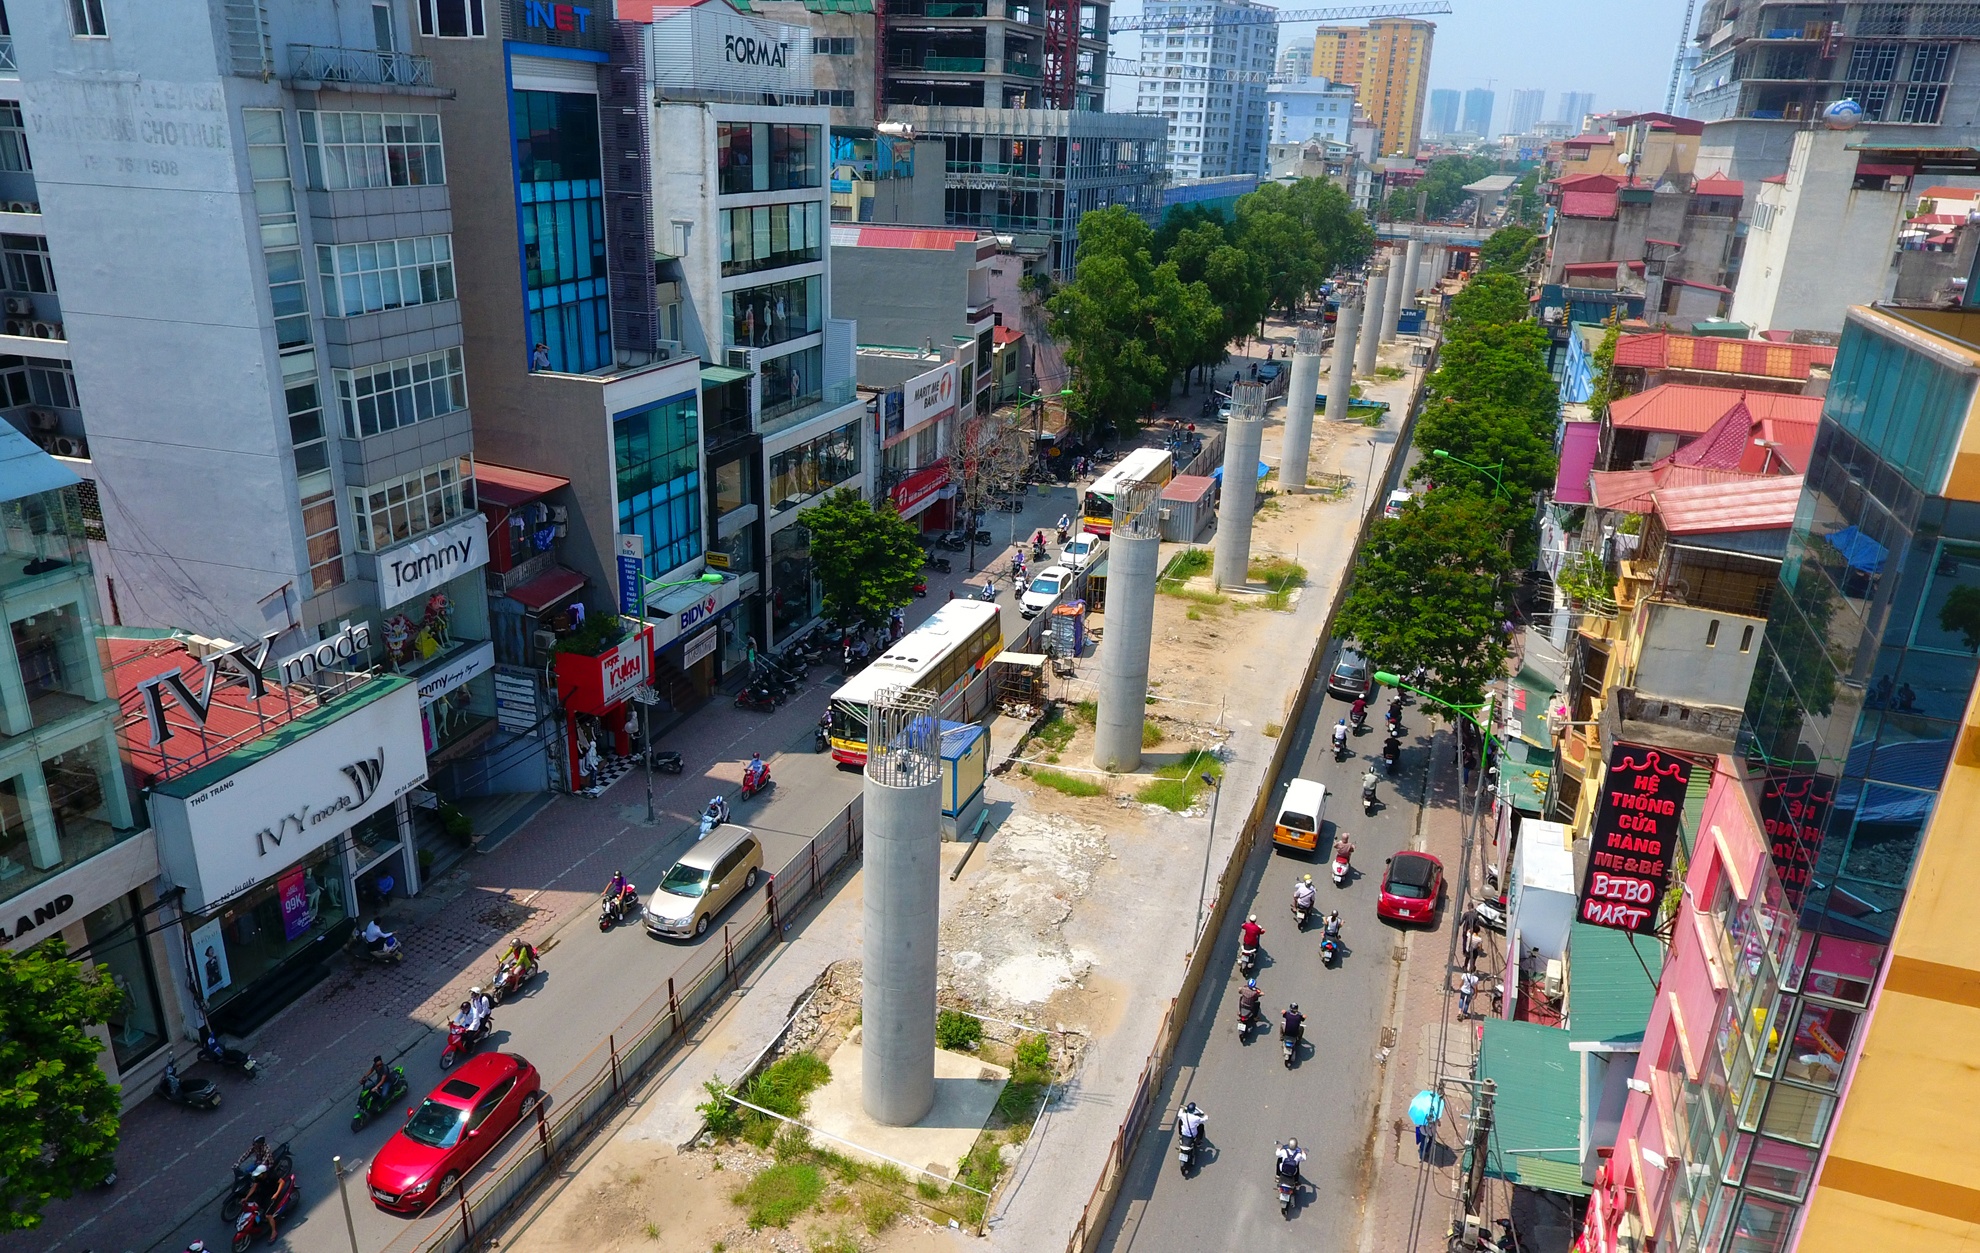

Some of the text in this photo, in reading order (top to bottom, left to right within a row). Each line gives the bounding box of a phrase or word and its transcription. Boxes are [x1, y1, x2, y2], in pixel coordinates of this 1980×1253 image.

[725, 34, 788, 68] FORMAT
[923, 392, 939, 410] BANK
[390, 536, 472, 588] Tammy
[681, 600, 706, 630] BIDV
[138, 625, 373, 746] IVY moda
[209, 780, 235, 797] TRANG
[1634, 774, 1661, 795] HỆ
[1611, 791, 1676, 817] THỐNG
[255, 795, 352, 858] IVY moda
[1618, 812, 1658, 835] CỬA
[1607, 832, 1663, 856] HÀNG
[1593, 851, 1664, 877] MẸ&BÉ
[1593, 873, 1653, 904] BIBO
[285, 893, 302, 914] 99K
[1586, 901, 1648, 929] MART
